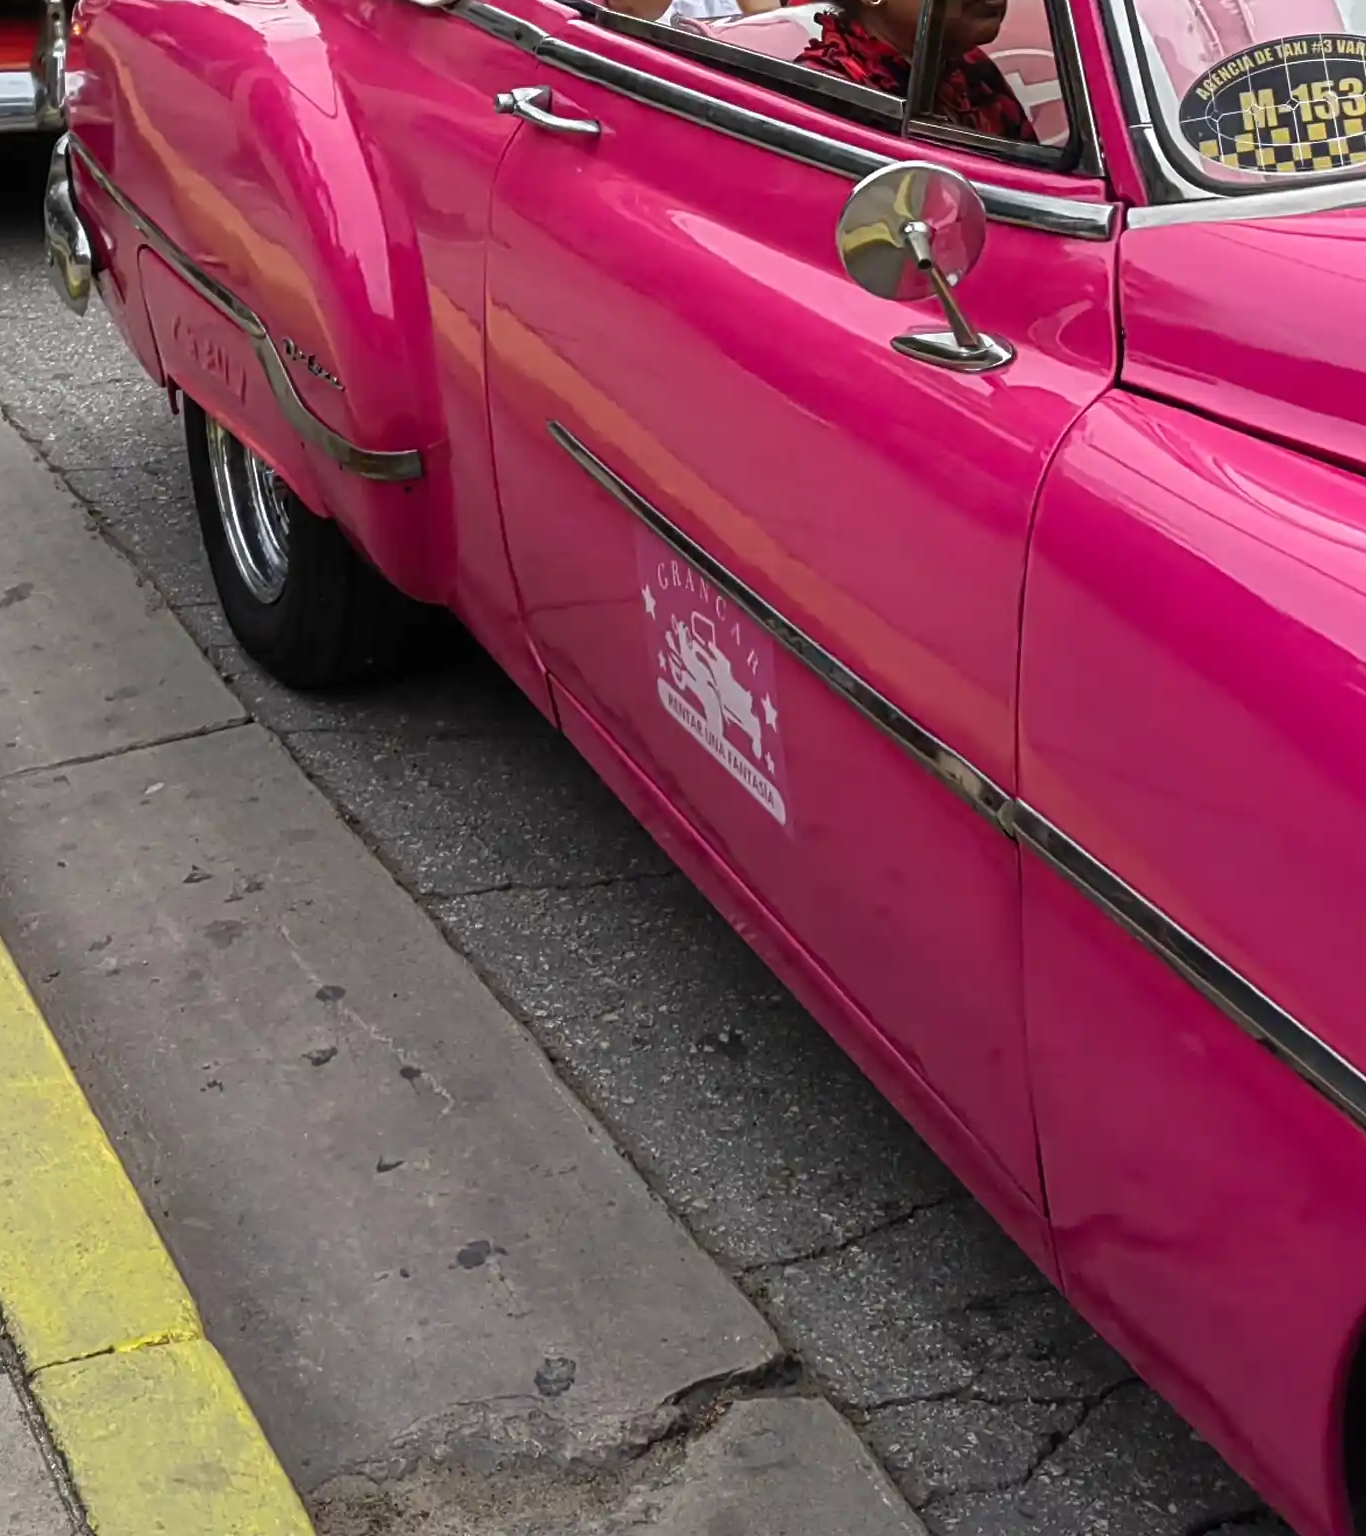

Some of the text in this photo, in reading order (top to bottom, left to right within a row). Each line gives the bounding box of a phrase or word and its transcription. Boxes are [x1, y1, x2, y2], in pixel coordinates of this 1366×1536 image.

[1195, 54, 1255, 101] AGENCIA
[1253, 47, 1275, 66] DE
[1274, 40, 1309, 60] TAXI
[1311, 39, 1333, 54] #3
